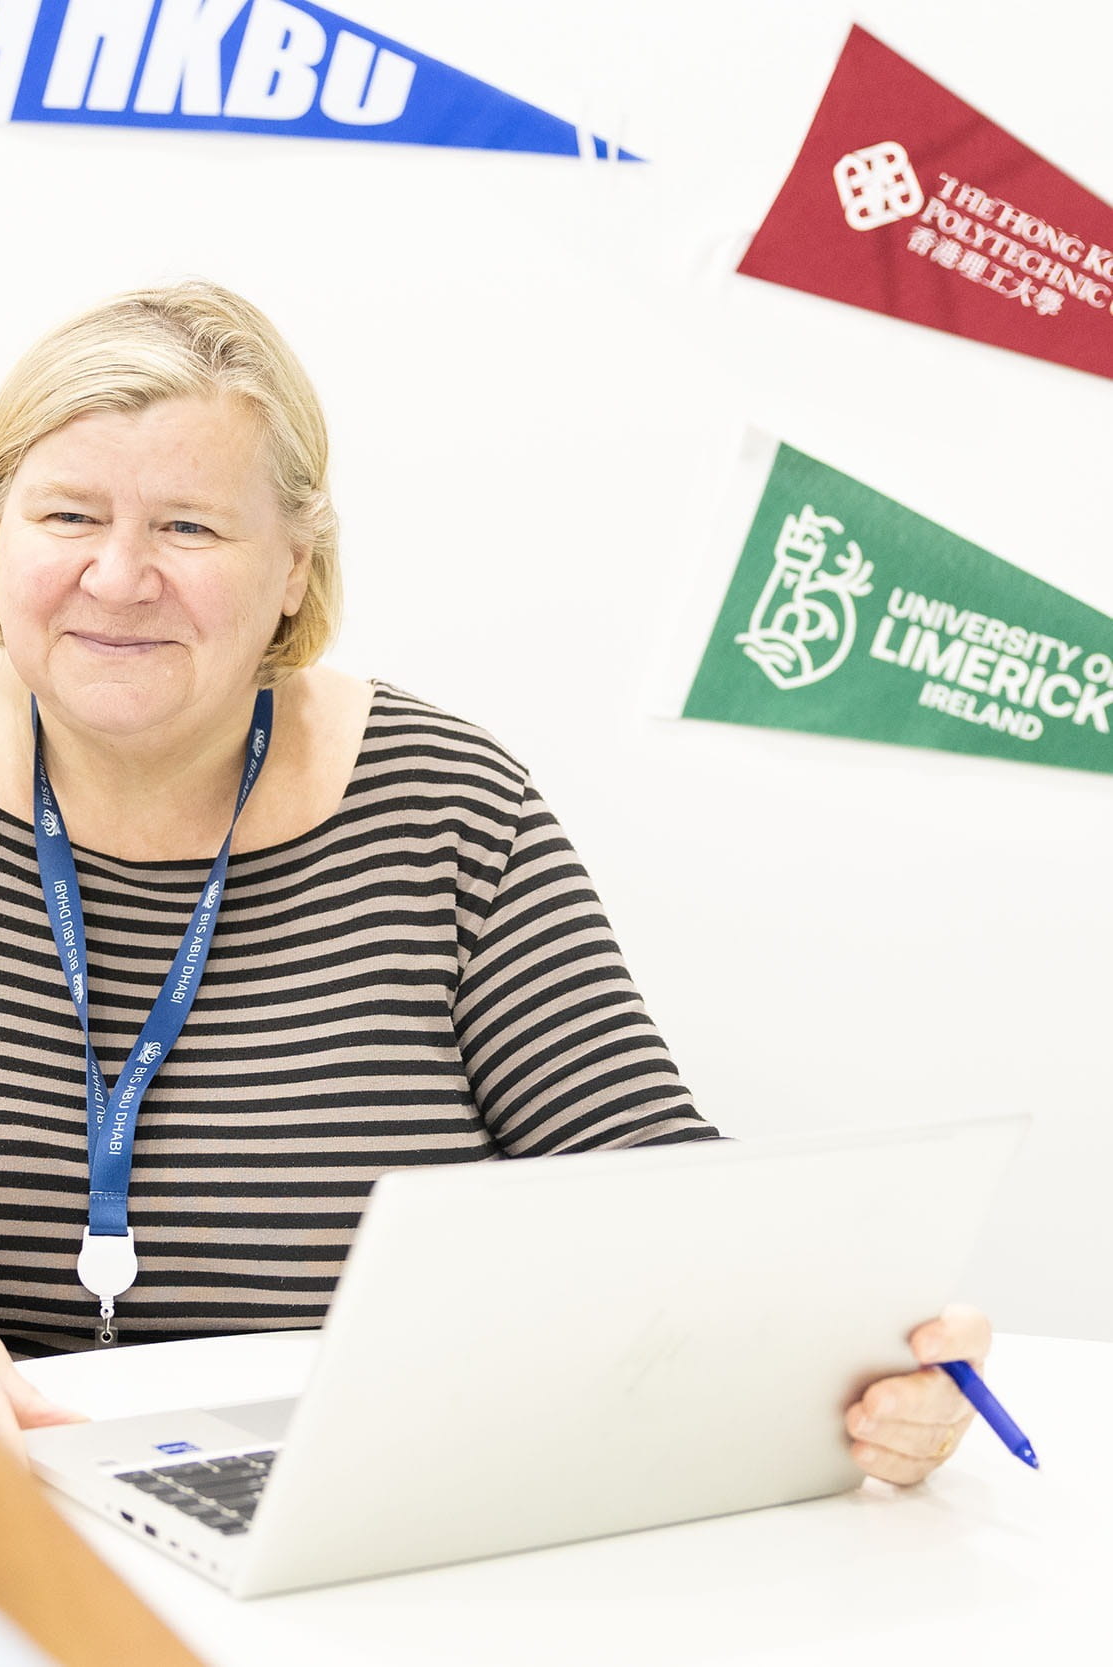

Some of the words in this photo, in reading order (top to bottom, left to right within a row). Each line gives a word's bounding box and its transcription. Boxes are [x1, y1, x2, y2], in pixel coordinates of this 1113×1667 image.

[938, 172, 998, 221] THE
[995, 197, 1085, 263] HONG
[907, 225, 1065, 316] 香港理工大學
[919, 195, 1112, 309] POLYTECHNIC
[886, 586, 1083, 673] UNIVERSITY
[869, 615, 1113, 735] LIMERICK
[918, 680, 1044, 741] IRELAND
[247, 758, 258, 780] BIS
[41, 785, 52, 806] BIS
[54, 879, 72, 920] DHABI
[61, 920, 76, 946] ABU
[196, 913, 211, 934] BIS
[67, 947, 79, 972] BIS
[186, 936, 203, 963] ABU
[170, 965, 195, 1004] DHABI
[91, 1060, 104, 1103] DHABI
[129, 1067, 148, 1084] BIS
[119, 1085, 137, 1109] ABU
[96, 1104, 106, 1130] BU
[108, 1112, 128, 1155] DHABI
